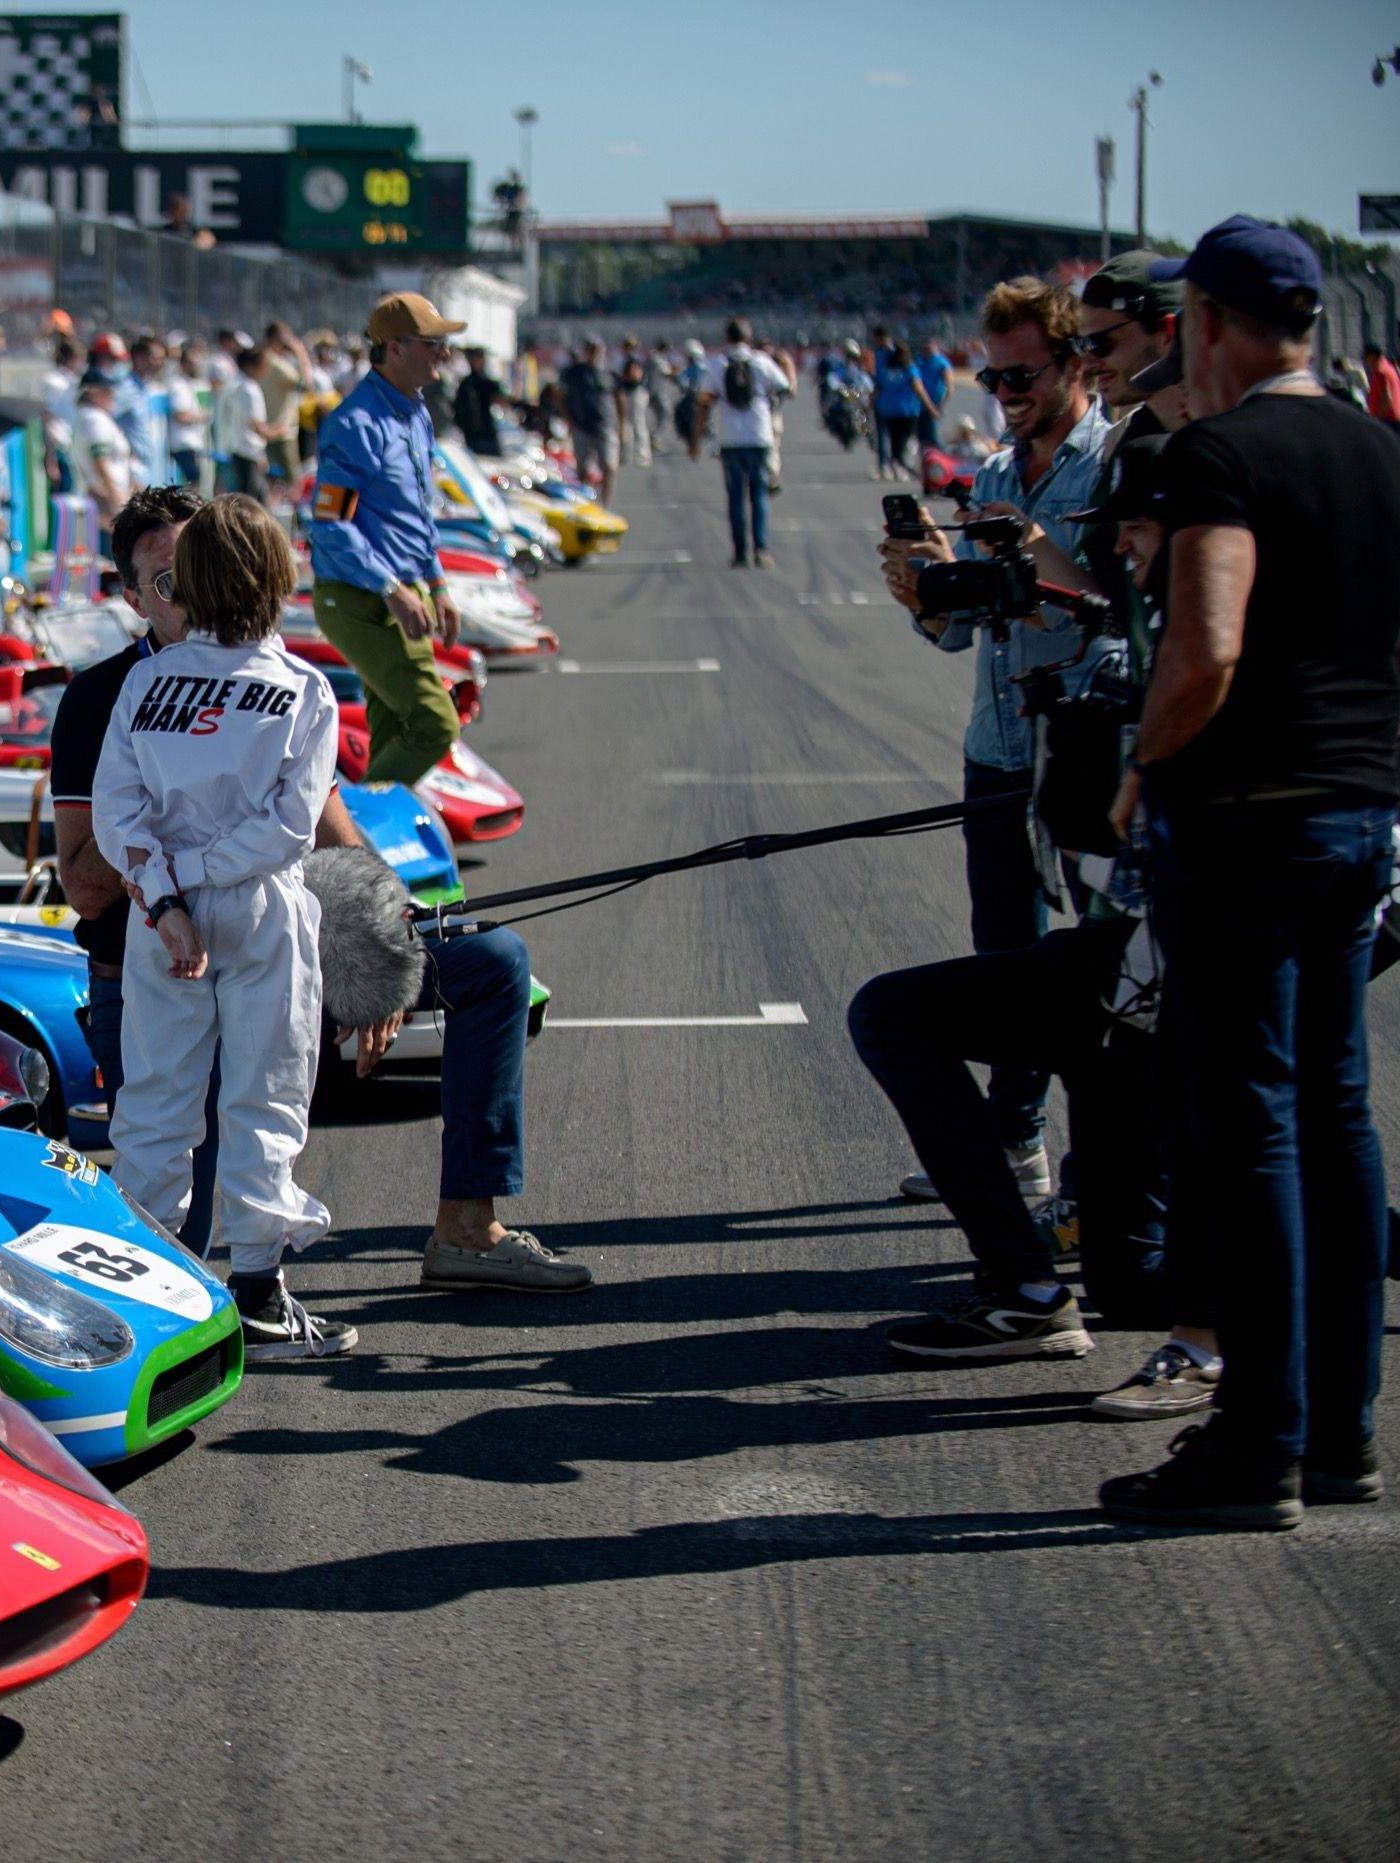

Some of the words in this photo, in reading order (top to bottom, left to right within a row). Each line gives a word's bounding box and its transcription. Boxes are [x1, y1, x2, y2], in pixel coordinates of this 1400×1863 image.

[142, 676, 237, 708] LITTLE
[236, 683, 297, 717] BIG
[130, 703, 225, 736] MANS
[57, 1241, 150, 1283] 63
